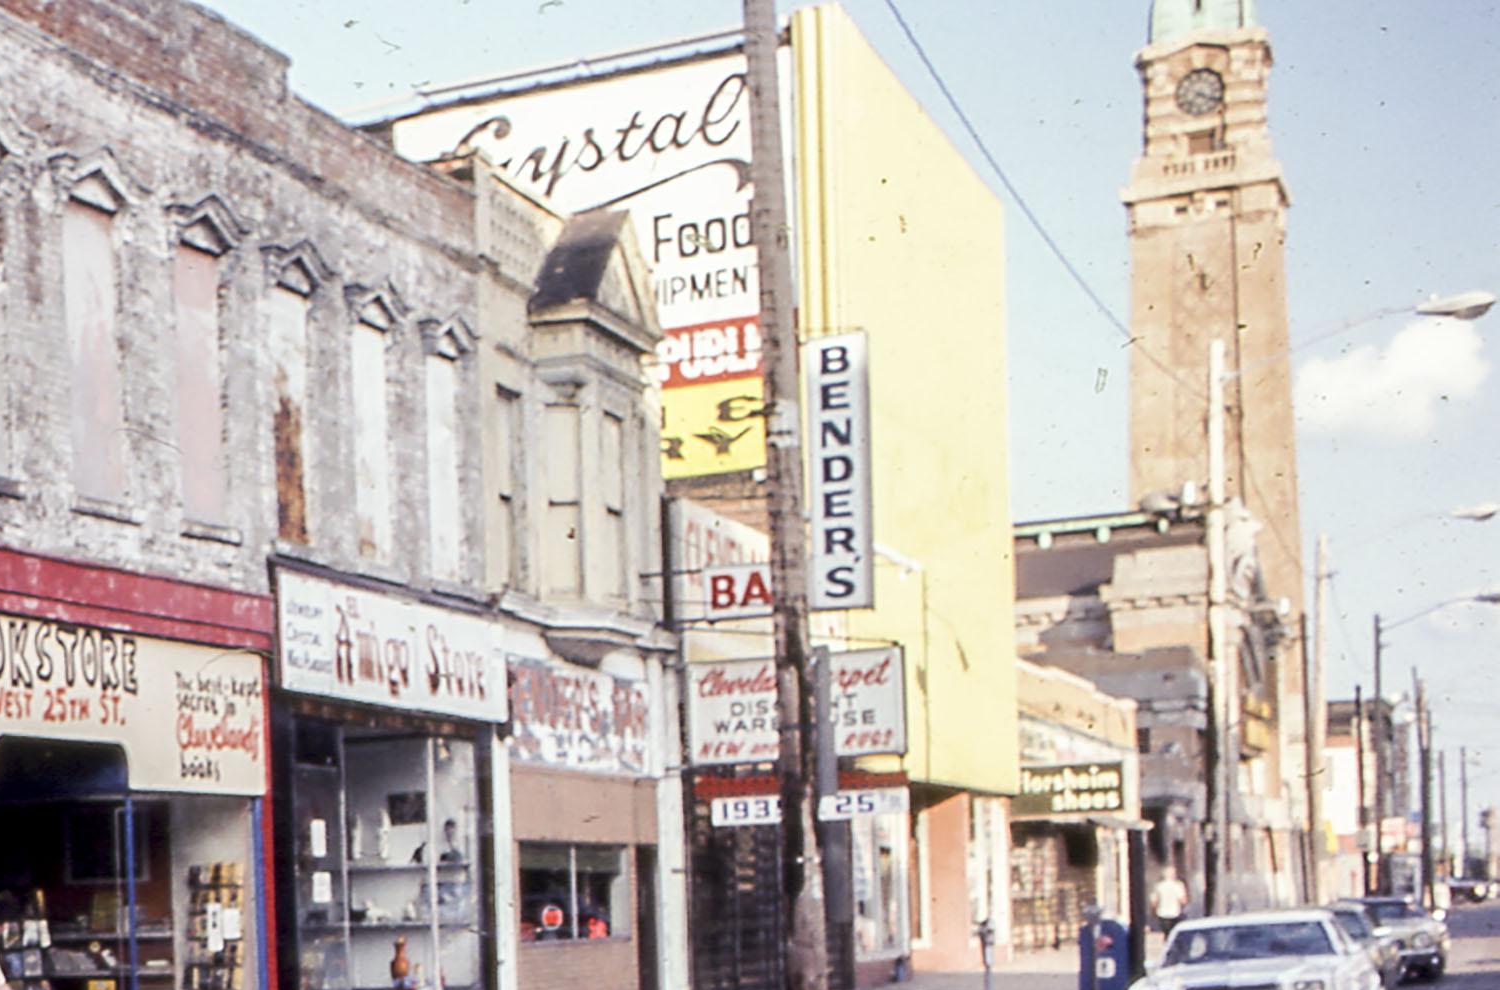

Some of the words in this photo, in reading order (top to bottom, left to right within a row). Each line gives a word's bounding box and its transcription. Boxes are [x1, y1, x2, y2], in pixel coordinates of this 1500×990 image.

[655, 264, 758, 306] IPMEN
[819, 345, 861, 599] BENDER'S
[711, 570, 773, 611] BA
[335, 603, 410, 698] Amigo
[426, 624, 486, 701] Store
[696, 664, 778, 698] Clevela
[832, 656, 892, 694] rpet
[43, 687, 91, 722] 25TH
[99, 691, 127, 726] ST.
[1019, 764, 1120, 794] lorsheim
[1051, 787, 1120, 812] shoes
[722, 799, 783, 821] 193
